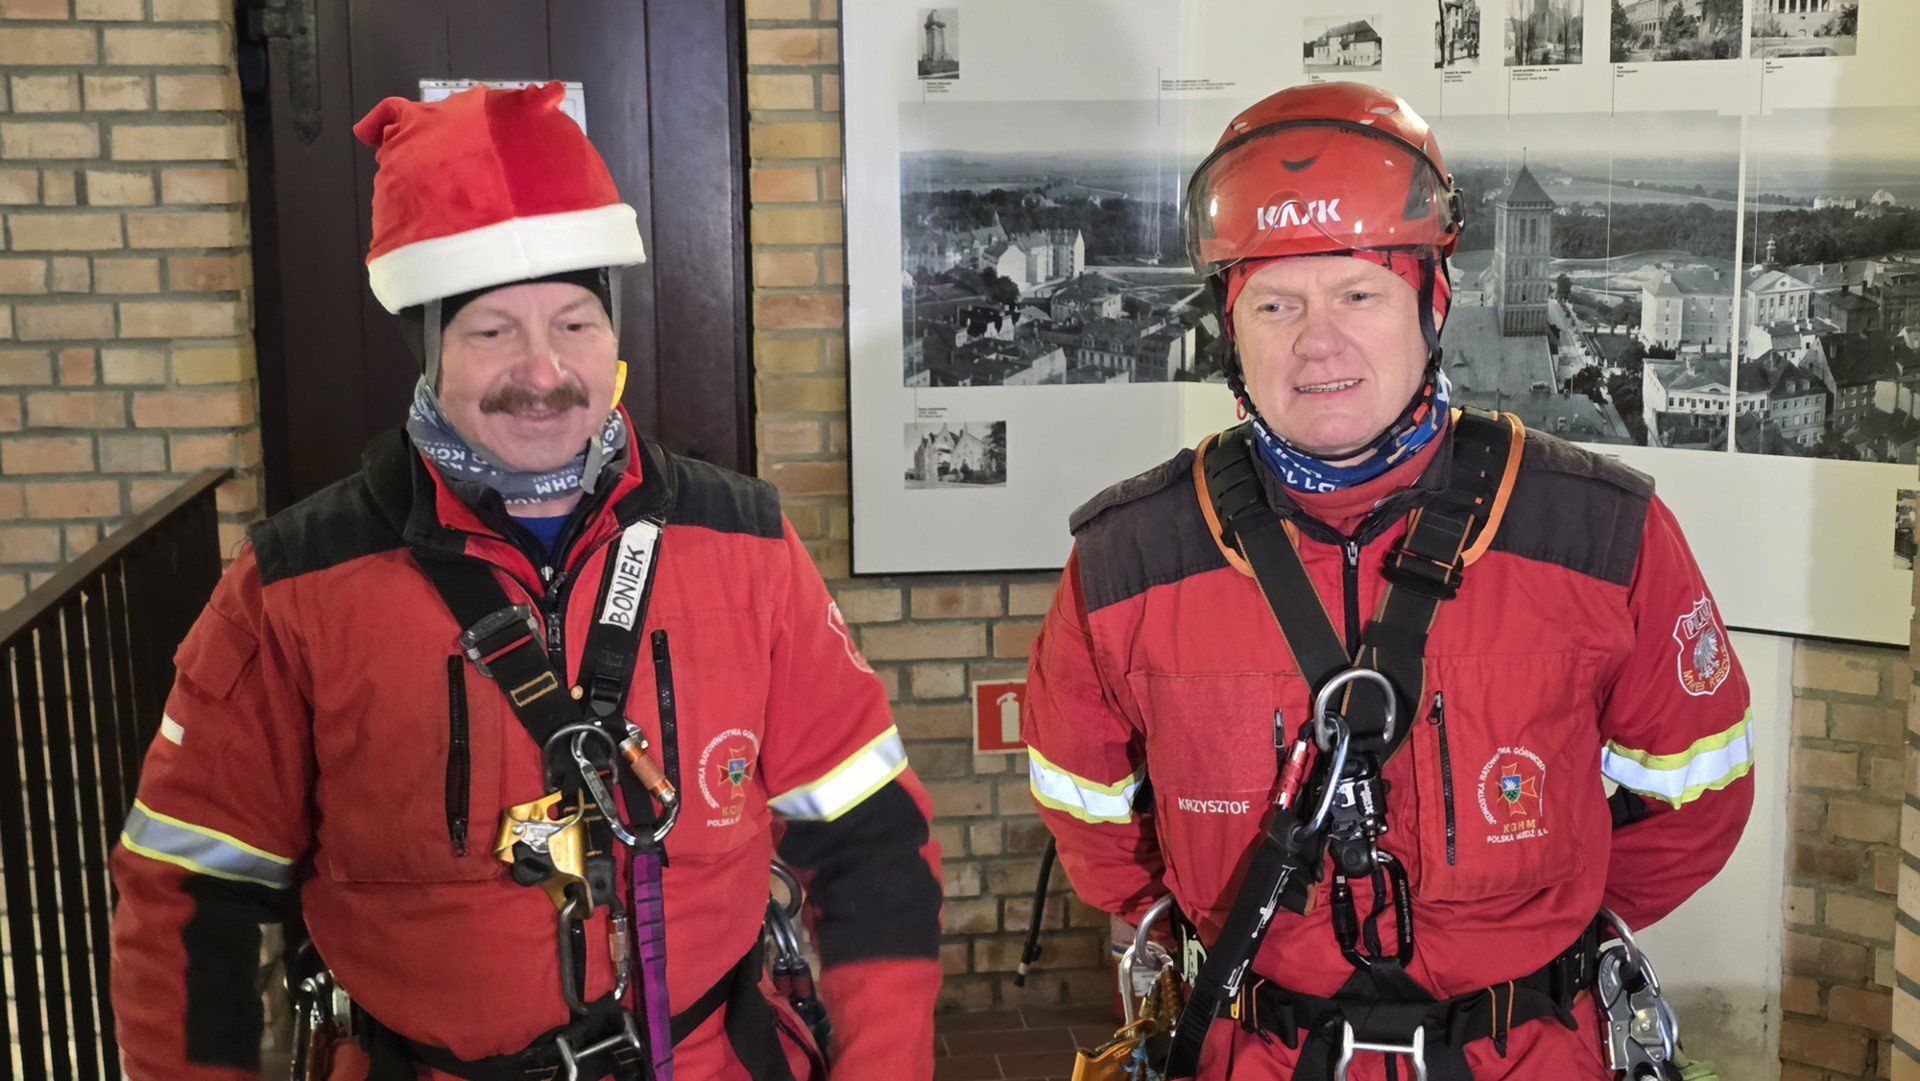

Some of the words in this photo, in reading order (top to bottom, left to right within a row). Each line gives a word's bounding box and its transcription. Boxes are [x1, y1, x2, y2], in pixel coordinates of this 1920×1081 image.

[1256, 198, 1342, 231] KASK
[608, 544, 646, 627] BONIEK
[1177, 796, 1251, 815] KRZYSZTOF
[1477, 783, 1498, 826] JEDNOSTKA
[1487, 833, 1515, 843] POLSKA
[1503, 818, 1536, 834] KGHM
